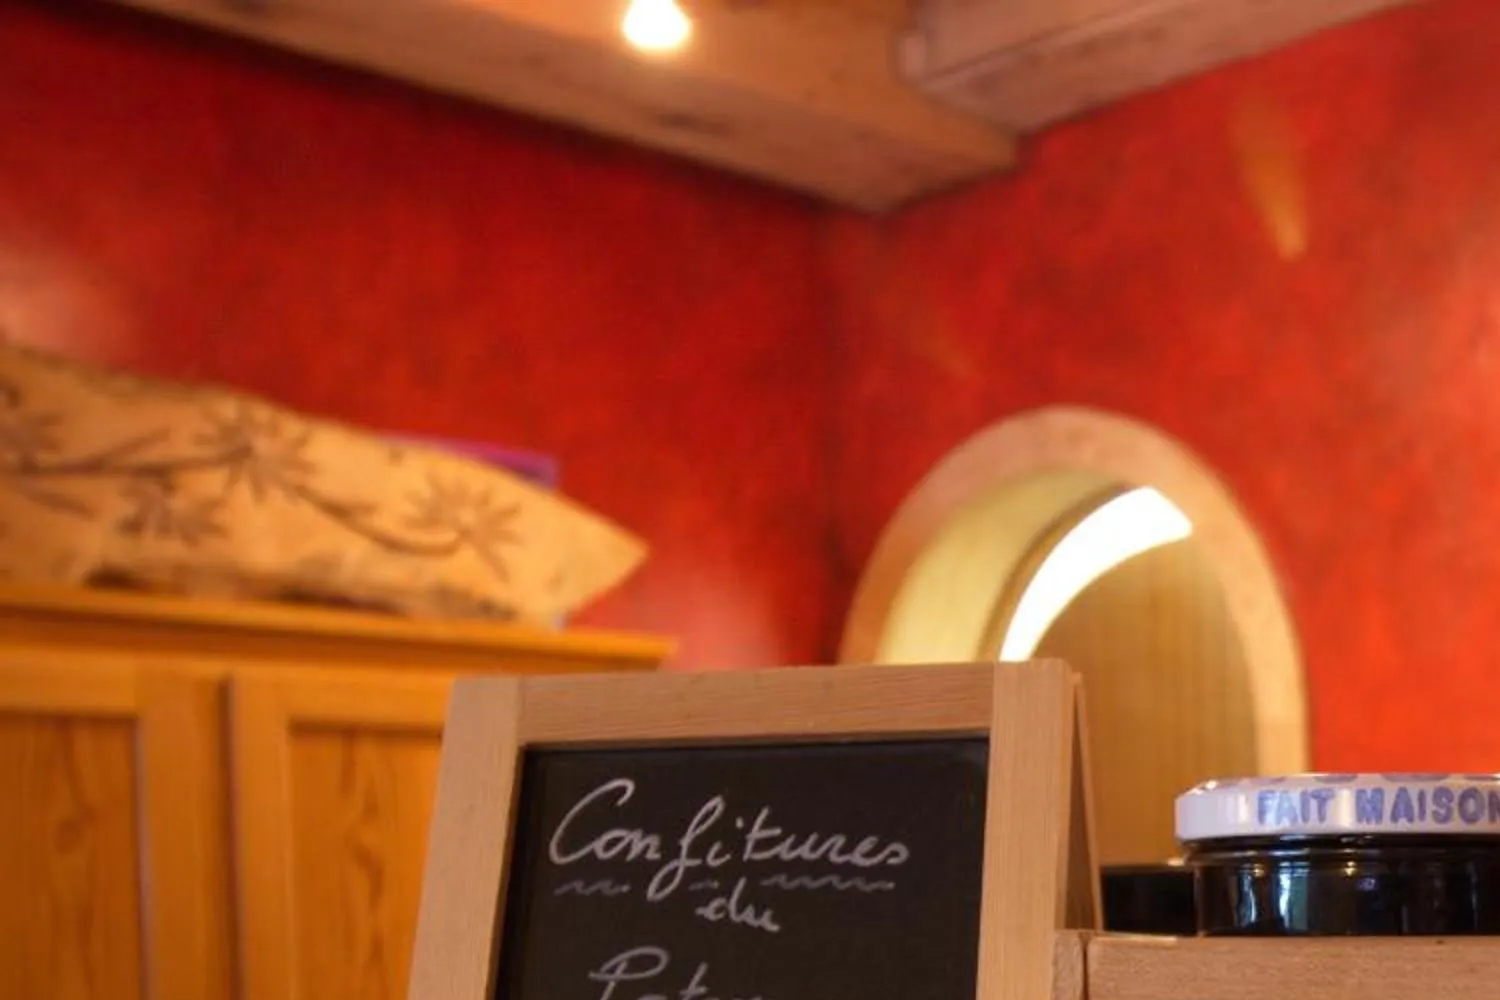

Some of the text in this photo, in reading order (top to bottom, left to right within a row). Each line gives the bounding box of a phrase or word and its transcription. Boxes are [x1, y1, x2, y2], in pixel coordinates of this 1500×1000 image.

[1256, 788, 1336, 825] FAIT
[549, 778, 909, 900] Confitures
[695, 877, 781, 932] du
